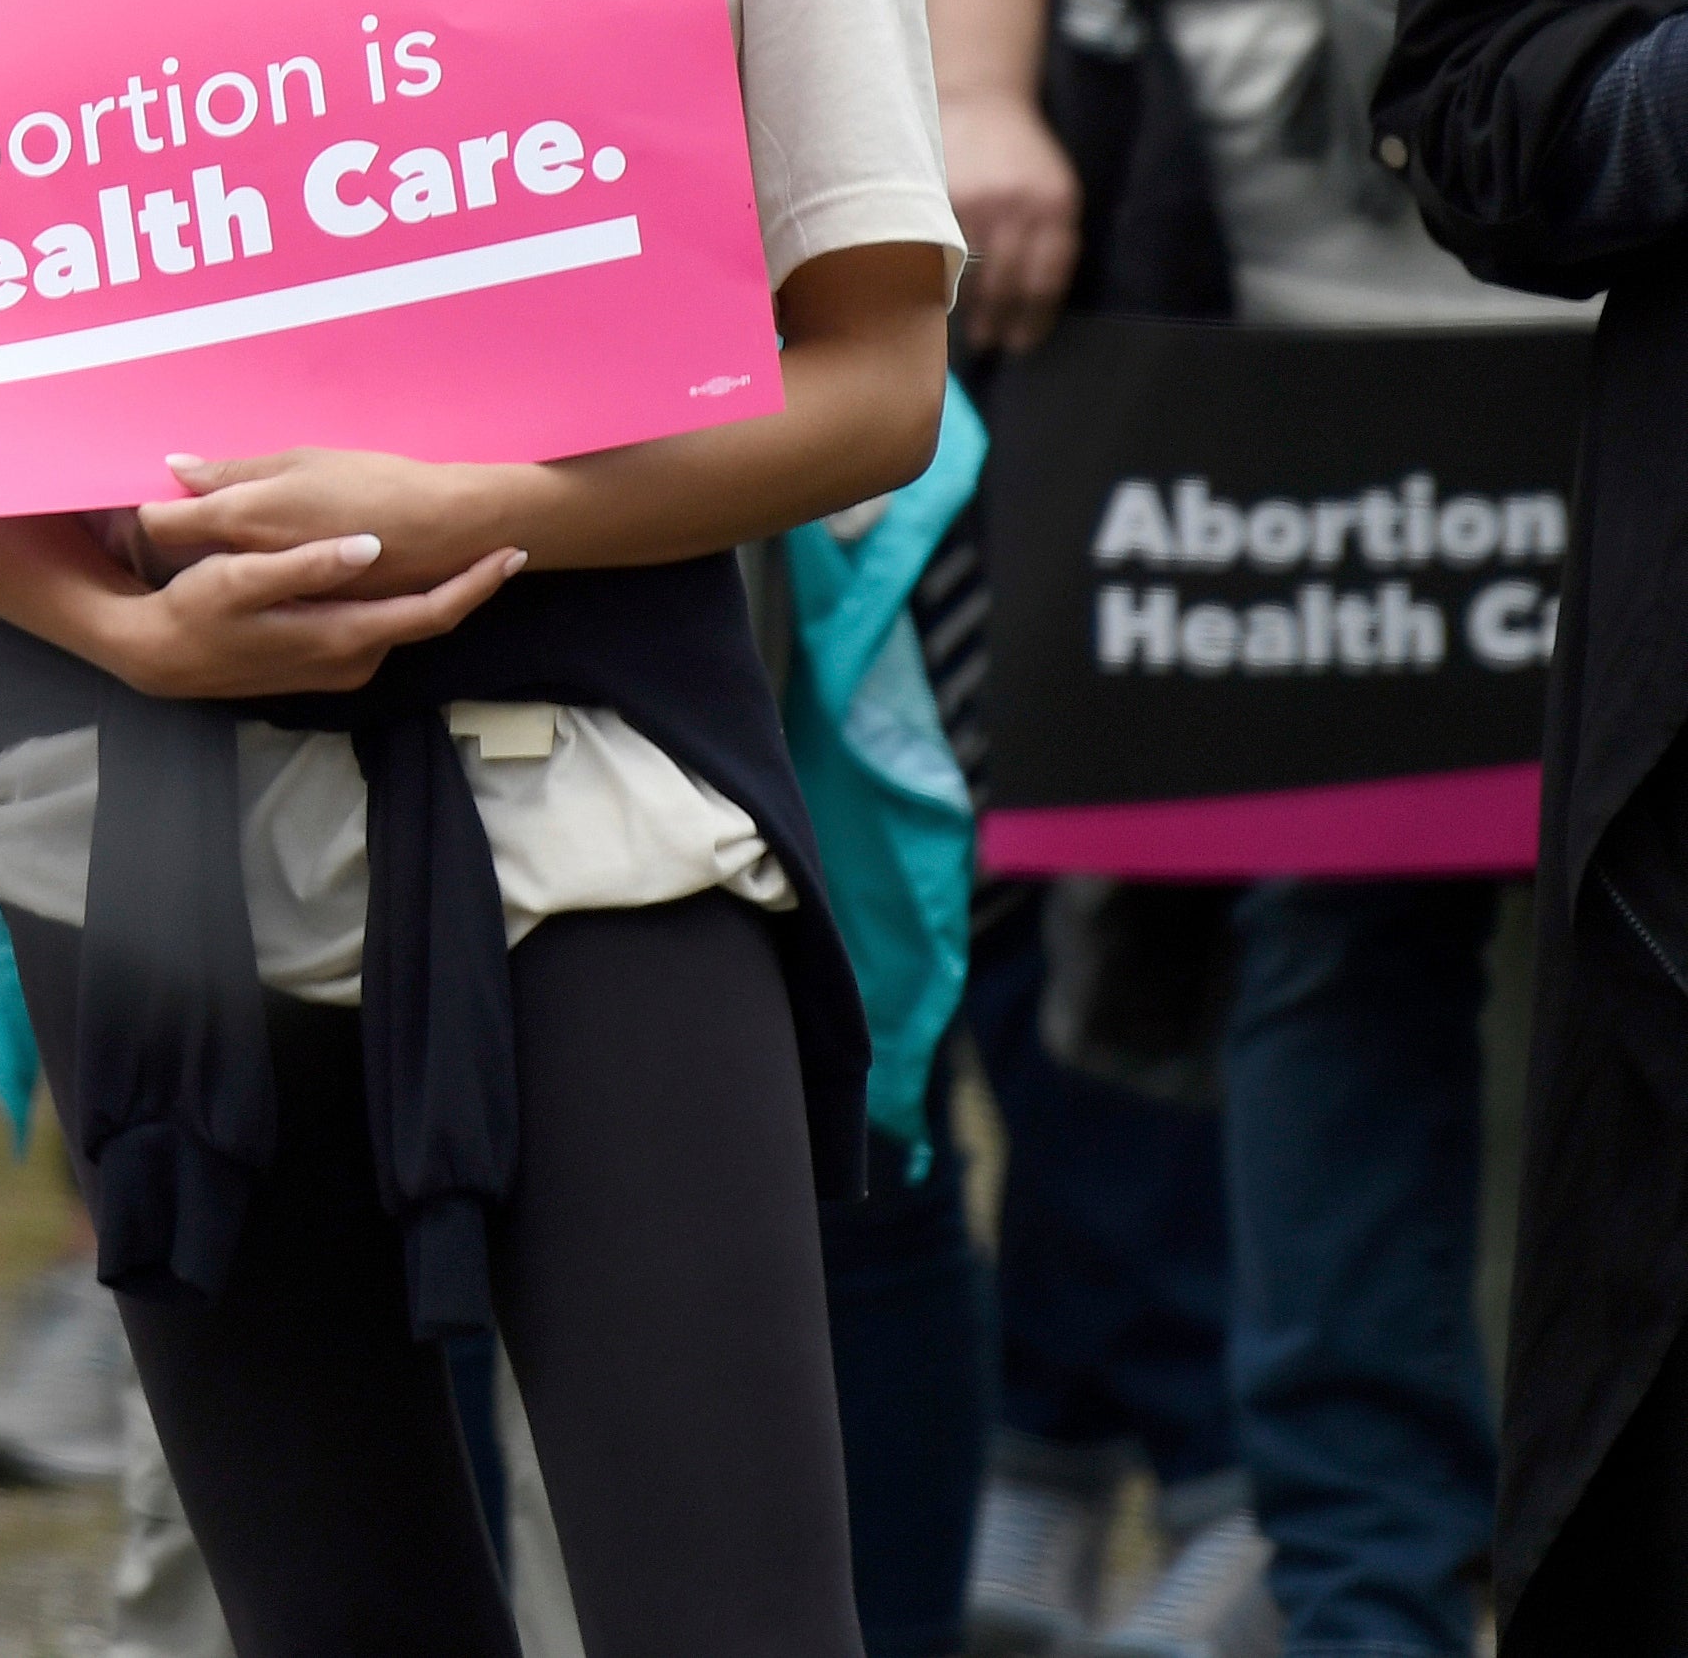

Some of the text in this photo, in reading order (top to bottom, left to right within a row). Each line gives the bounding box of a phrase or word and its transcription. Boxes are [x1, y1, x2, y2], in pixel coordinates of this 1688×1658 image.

[360, 13, 443, 106] is
[302, 118, 627, 239] Care.
[1091, 472, 1568, 567] Abortion
[1096, 582, 1445, 671] Health
